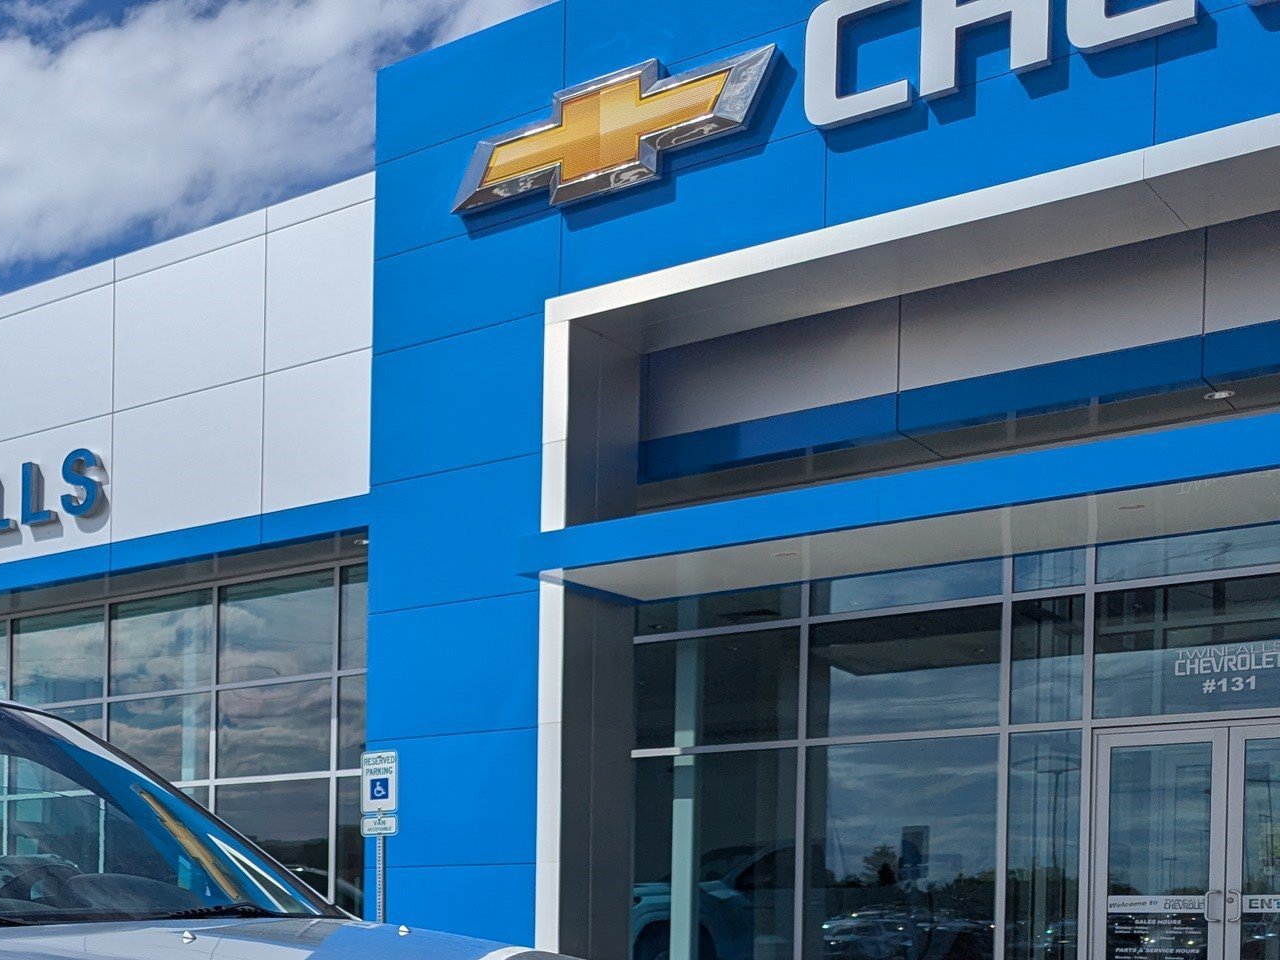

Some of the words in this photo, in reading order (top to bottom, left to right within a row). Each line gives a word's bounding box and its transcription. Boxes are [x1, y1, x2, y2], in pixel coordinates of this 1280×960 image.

[1174, 651, 1280, 676] CHEVROLE
[1202, 675, 1256, 693] #131
[364, 756, 395, 766] RESERVED
[365, 767, 393, 776] PARKING
